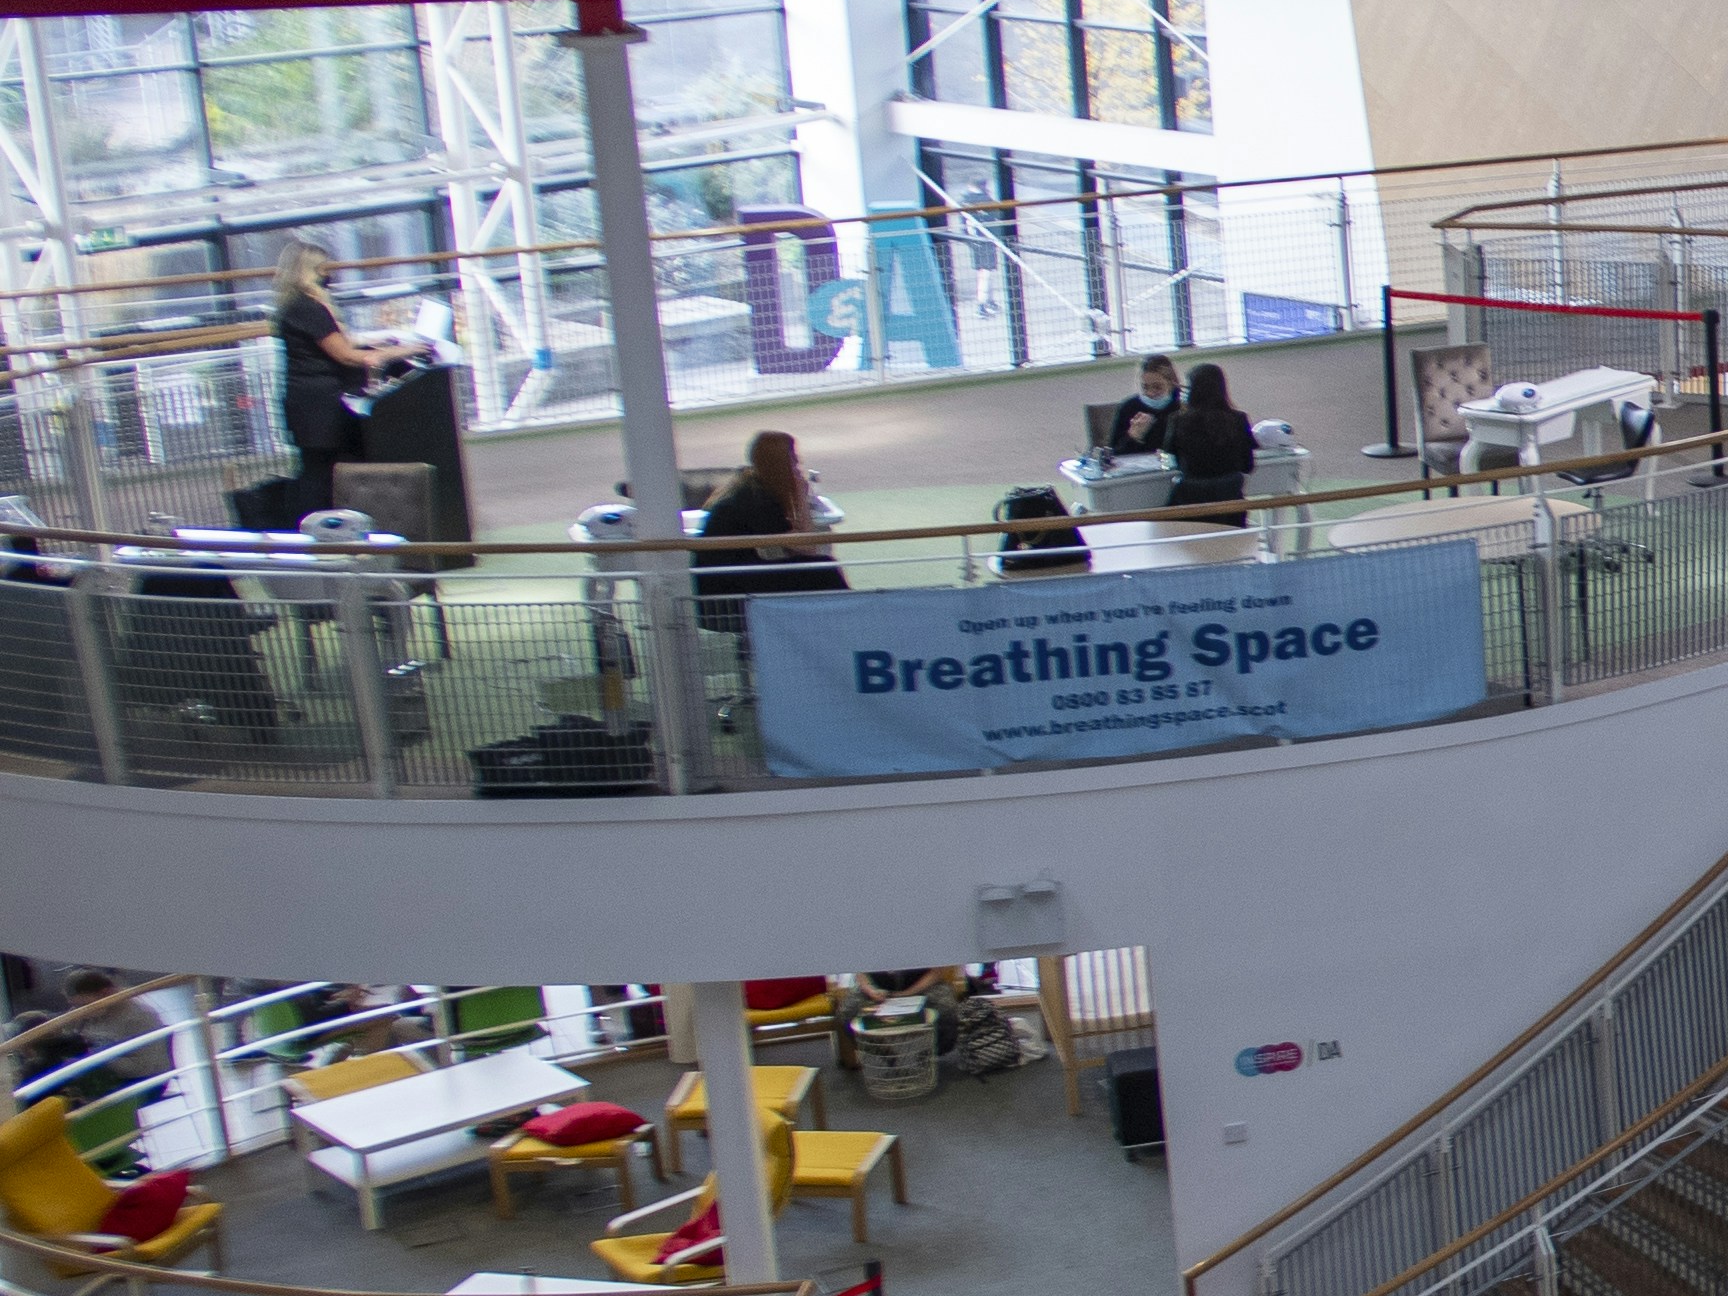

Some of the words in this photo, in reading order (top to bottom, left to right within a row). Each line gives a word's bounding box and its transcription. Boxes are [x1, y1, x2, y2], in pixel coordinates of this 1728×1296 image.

[958, 617, 1008, 634] Open
[1014, 615, 1039, 629] up
[1045, 610, 1096, 625] when
[1168, 597, 1236, 614] feeling
[1241, 594, 1292, 609] down
[853, 630, 1173, 694] Breathing
[1191, 616, 1380, 675] Space
[1051, 690, 1111, 710] 0800
[1116, 688, 1144, 705] 83
[1185, 679, 1213, 698] 87
[982, 700, 1288, 741] www.breathingspace.scot
